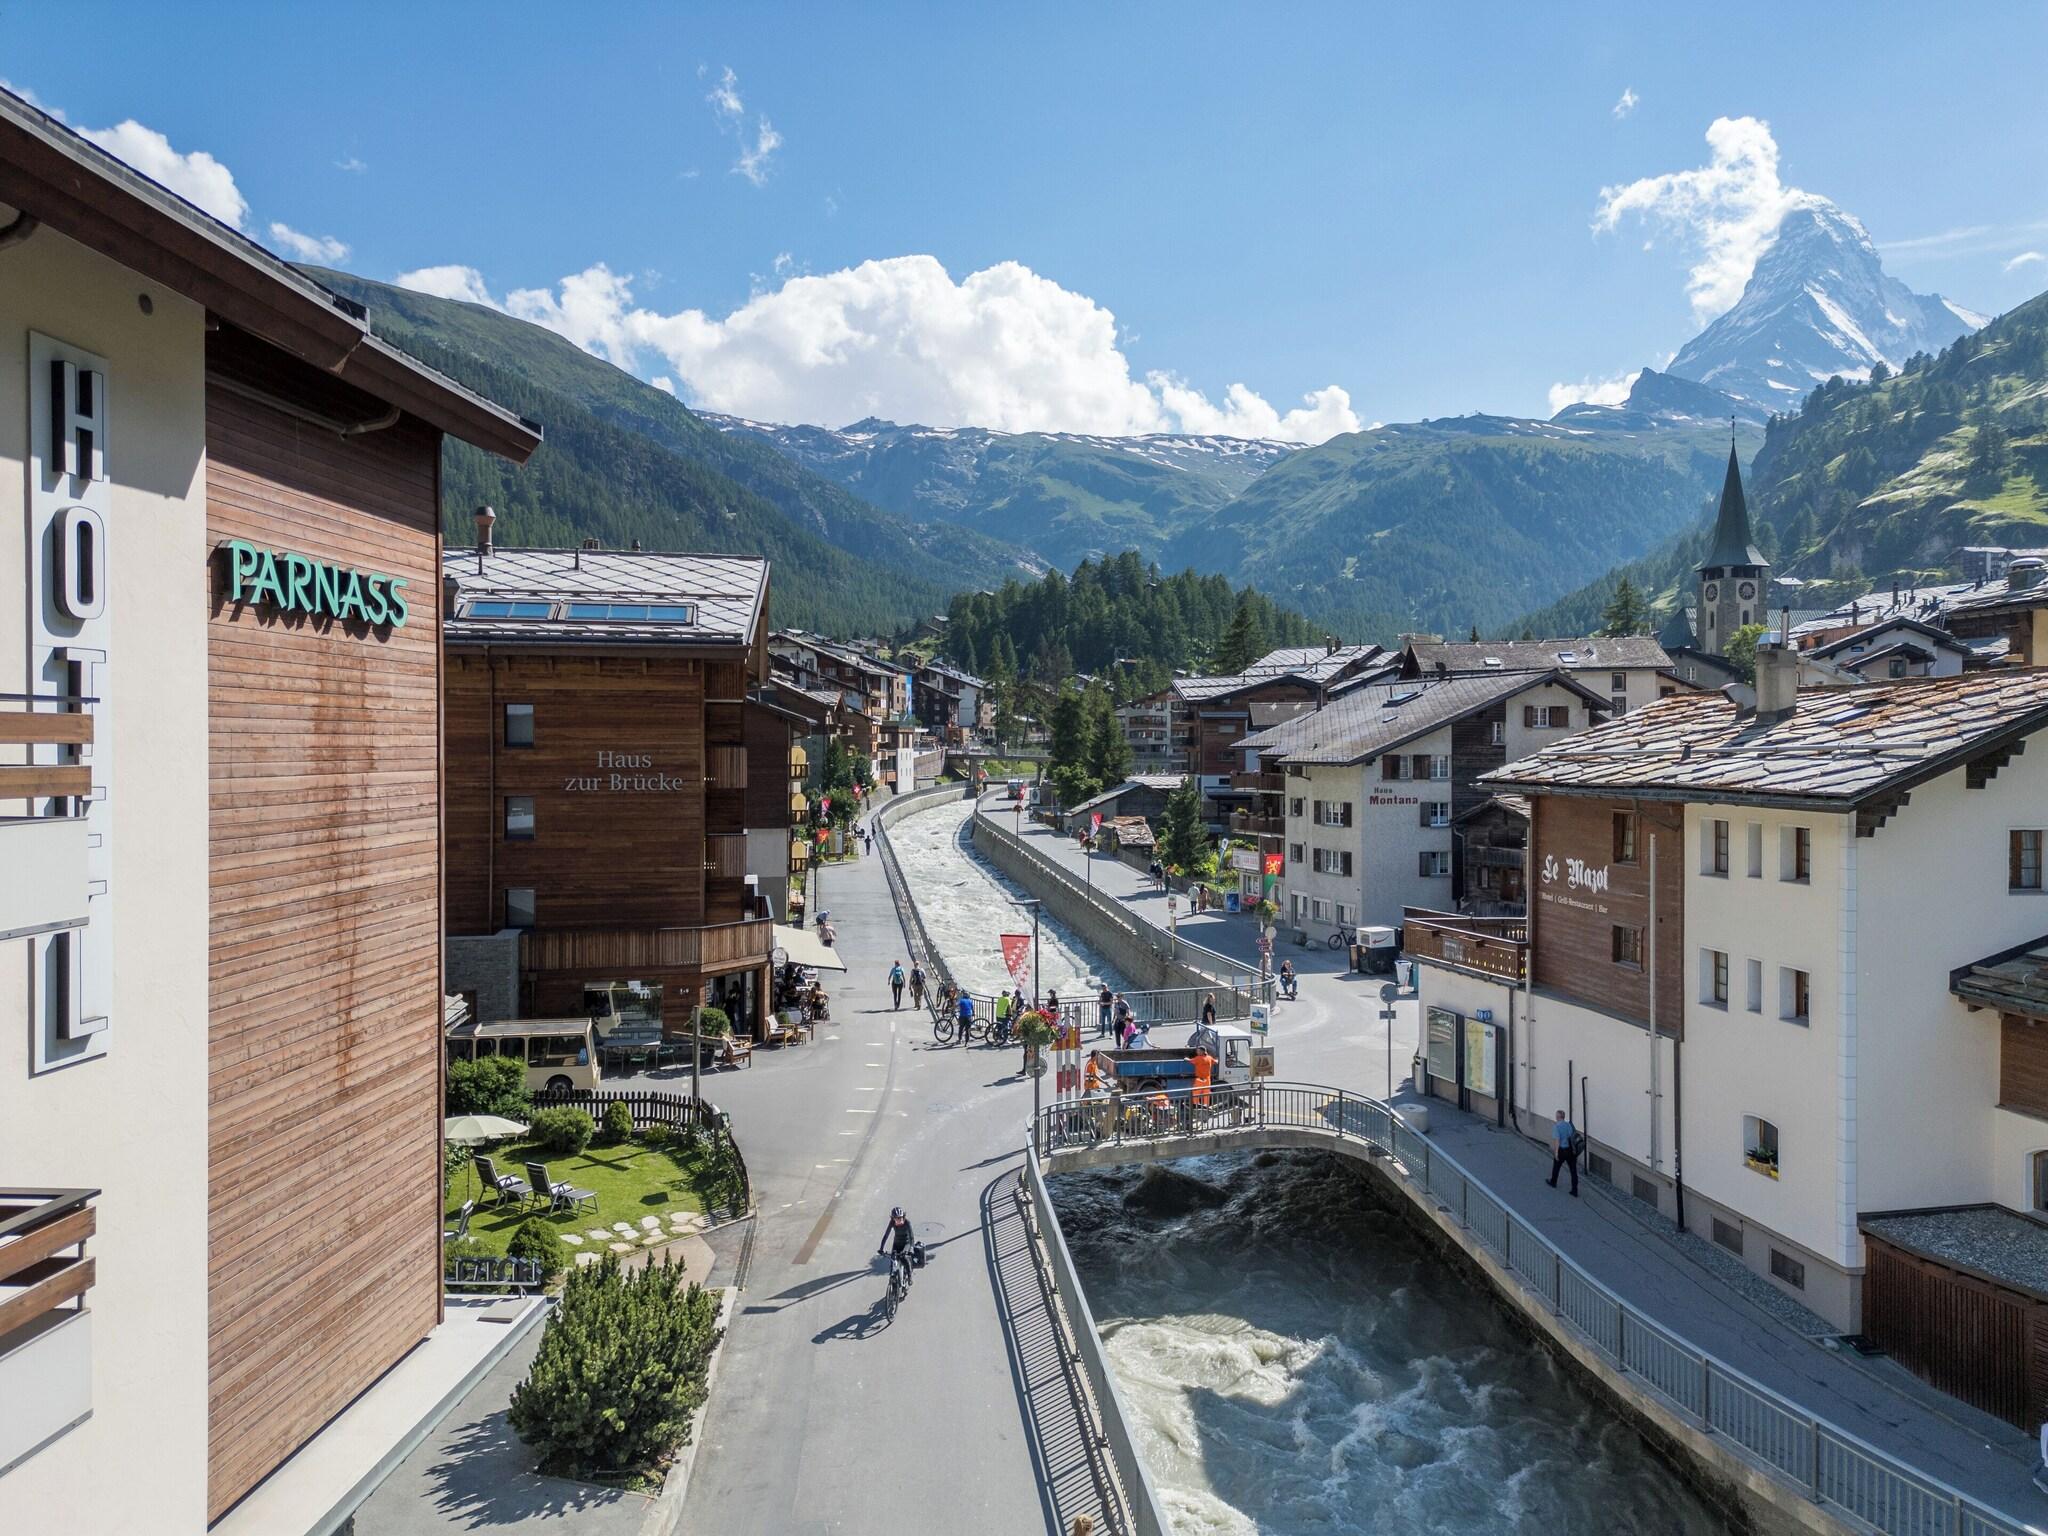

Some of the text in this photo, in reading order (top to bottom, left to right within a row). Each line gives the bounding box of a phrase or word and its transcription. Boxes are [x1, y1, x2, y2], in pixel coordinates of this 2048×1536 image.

[230, 540, 409, 628] PARNASS
[597, 750, 653, 769] Haus
[564, 772, 684, 792] zur Brücke
[1369, 794, 1418, 805] Montana
[1541, 853, 1609, 894] Le Mazot
